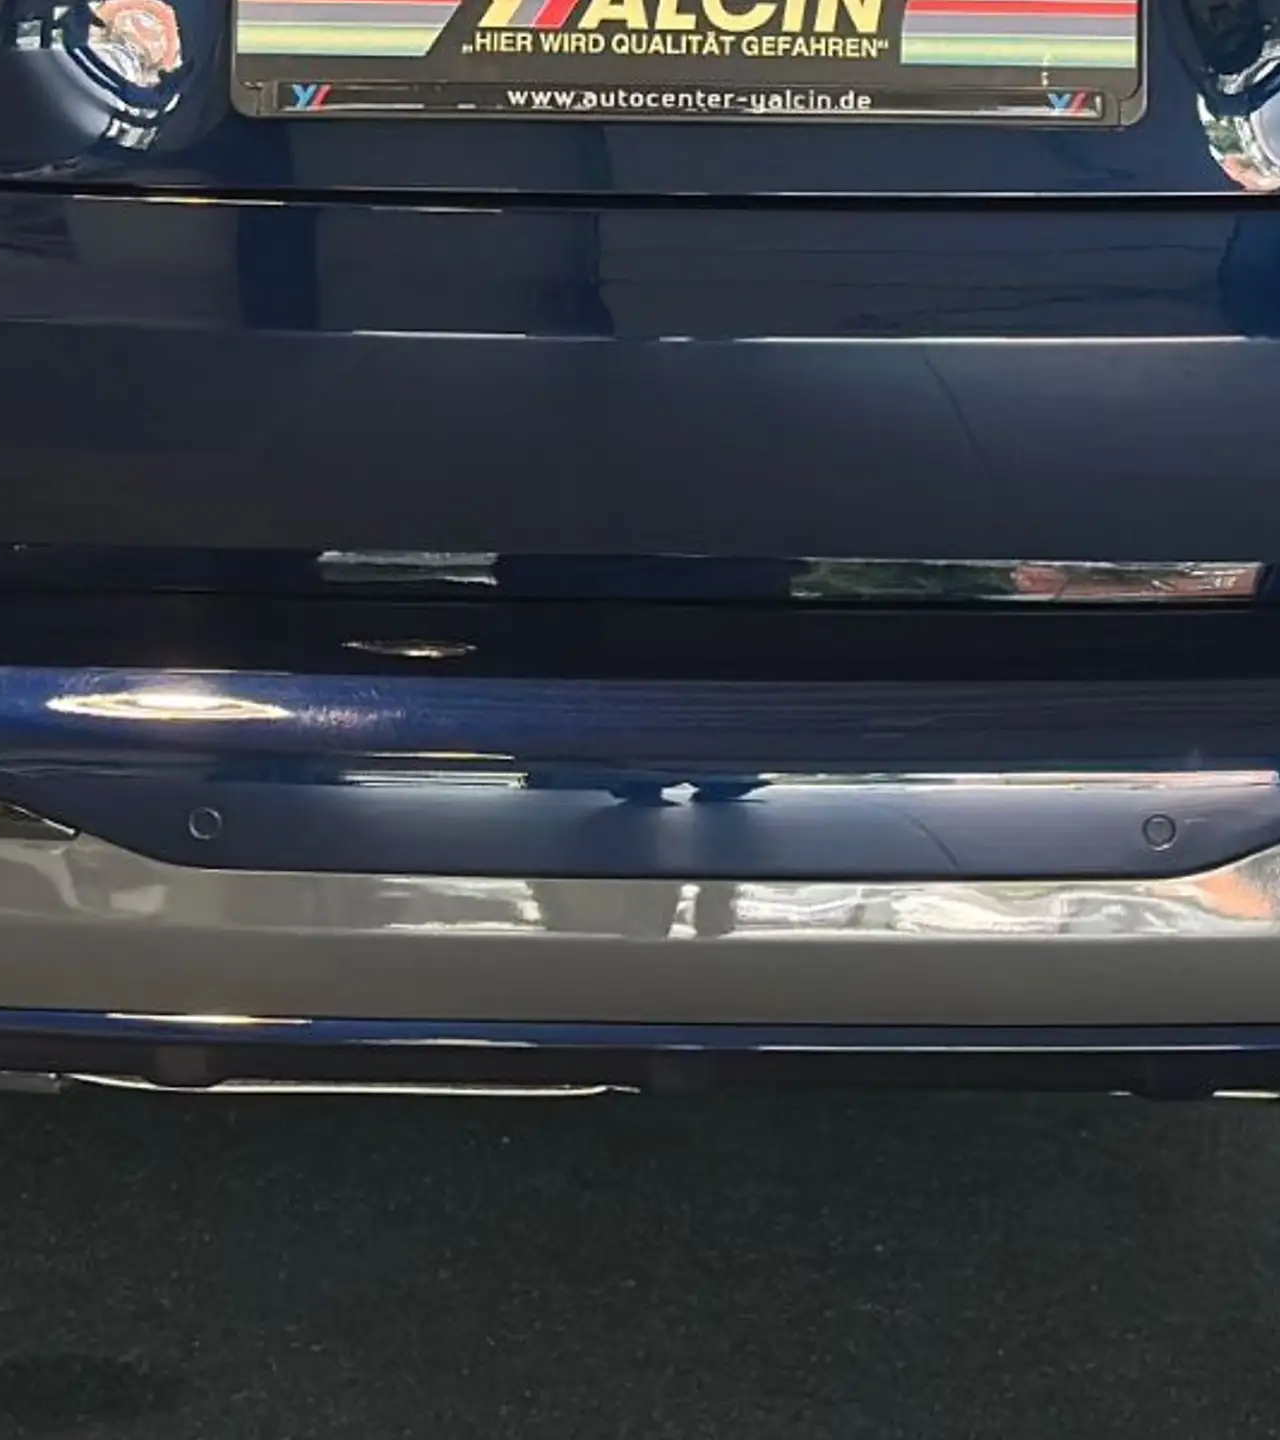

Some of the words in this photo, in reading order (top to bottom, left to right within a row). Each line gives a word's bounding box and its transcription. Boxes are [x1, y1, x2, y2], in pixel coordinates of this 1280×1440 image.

[539, 33, 606, 54] WIRD
[611, 31, 736, 57] QUALITÄT
[506, 88, 872, 112] www.autocenter-yalcin.de
